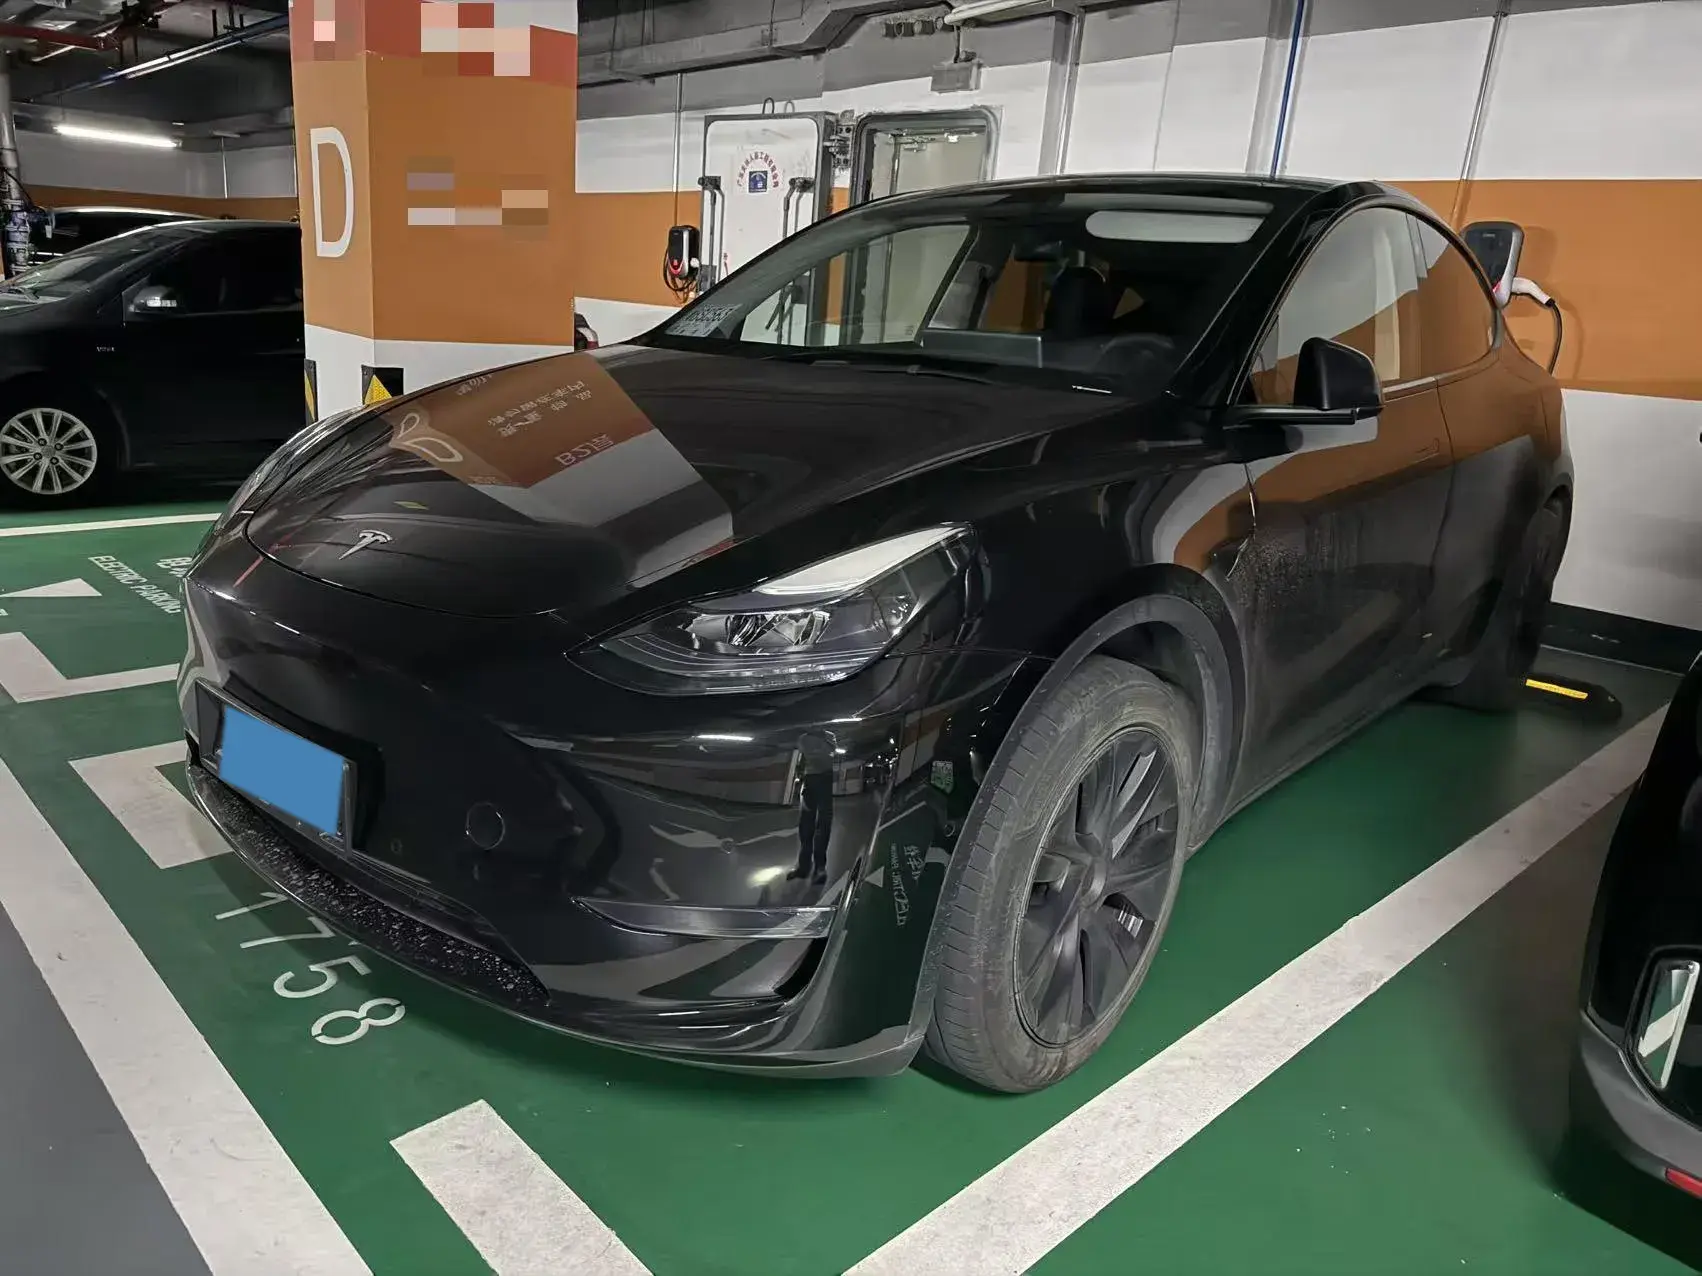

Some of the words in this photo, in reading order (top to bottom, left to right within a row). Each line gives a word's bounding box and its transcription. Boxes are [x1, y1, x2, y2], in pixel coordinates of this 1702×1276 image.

[310, 126, 354, 258] D
[88, 555, 148, 584] ELECTRIC
[215, 891, 406, 1045] 1758
